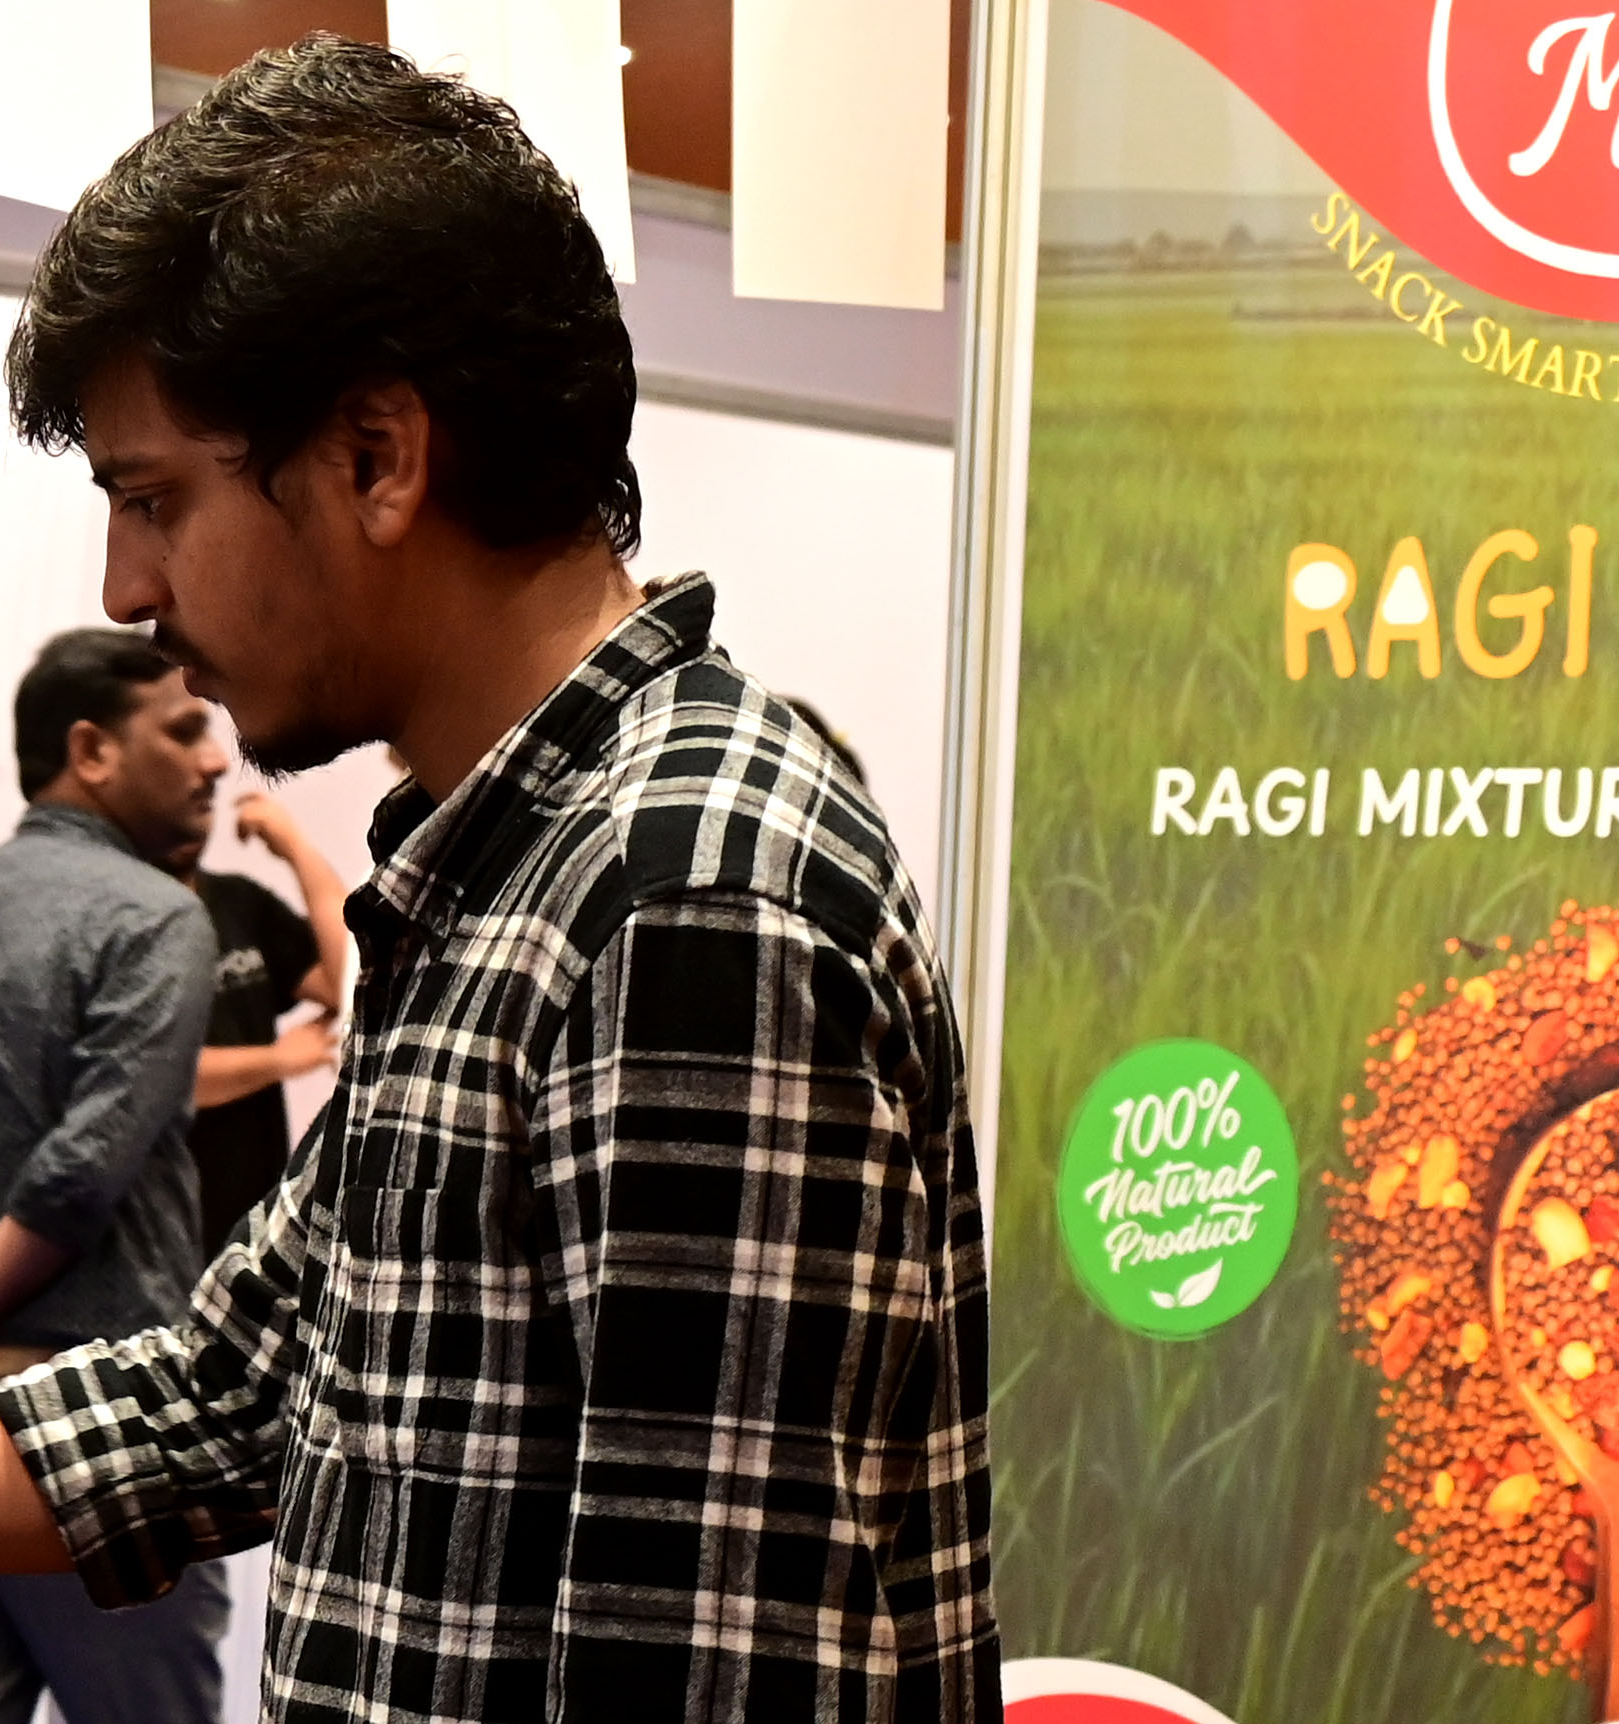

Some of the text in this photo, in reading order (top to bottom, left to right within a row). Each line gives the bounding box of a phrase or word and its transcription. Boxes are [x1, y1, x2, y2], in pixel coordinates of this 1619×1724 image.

[1311, 191, 1463, 347] SNACK
[1282, 524, 1598, 682] RAGI
[1150, 766, 1331, 838] RAGI
[1112, 1070, 1241, 1163] 100%
[1084, 1145, 1277, 1234] Natural
[1103, 1202, 1264, 1274] Product
